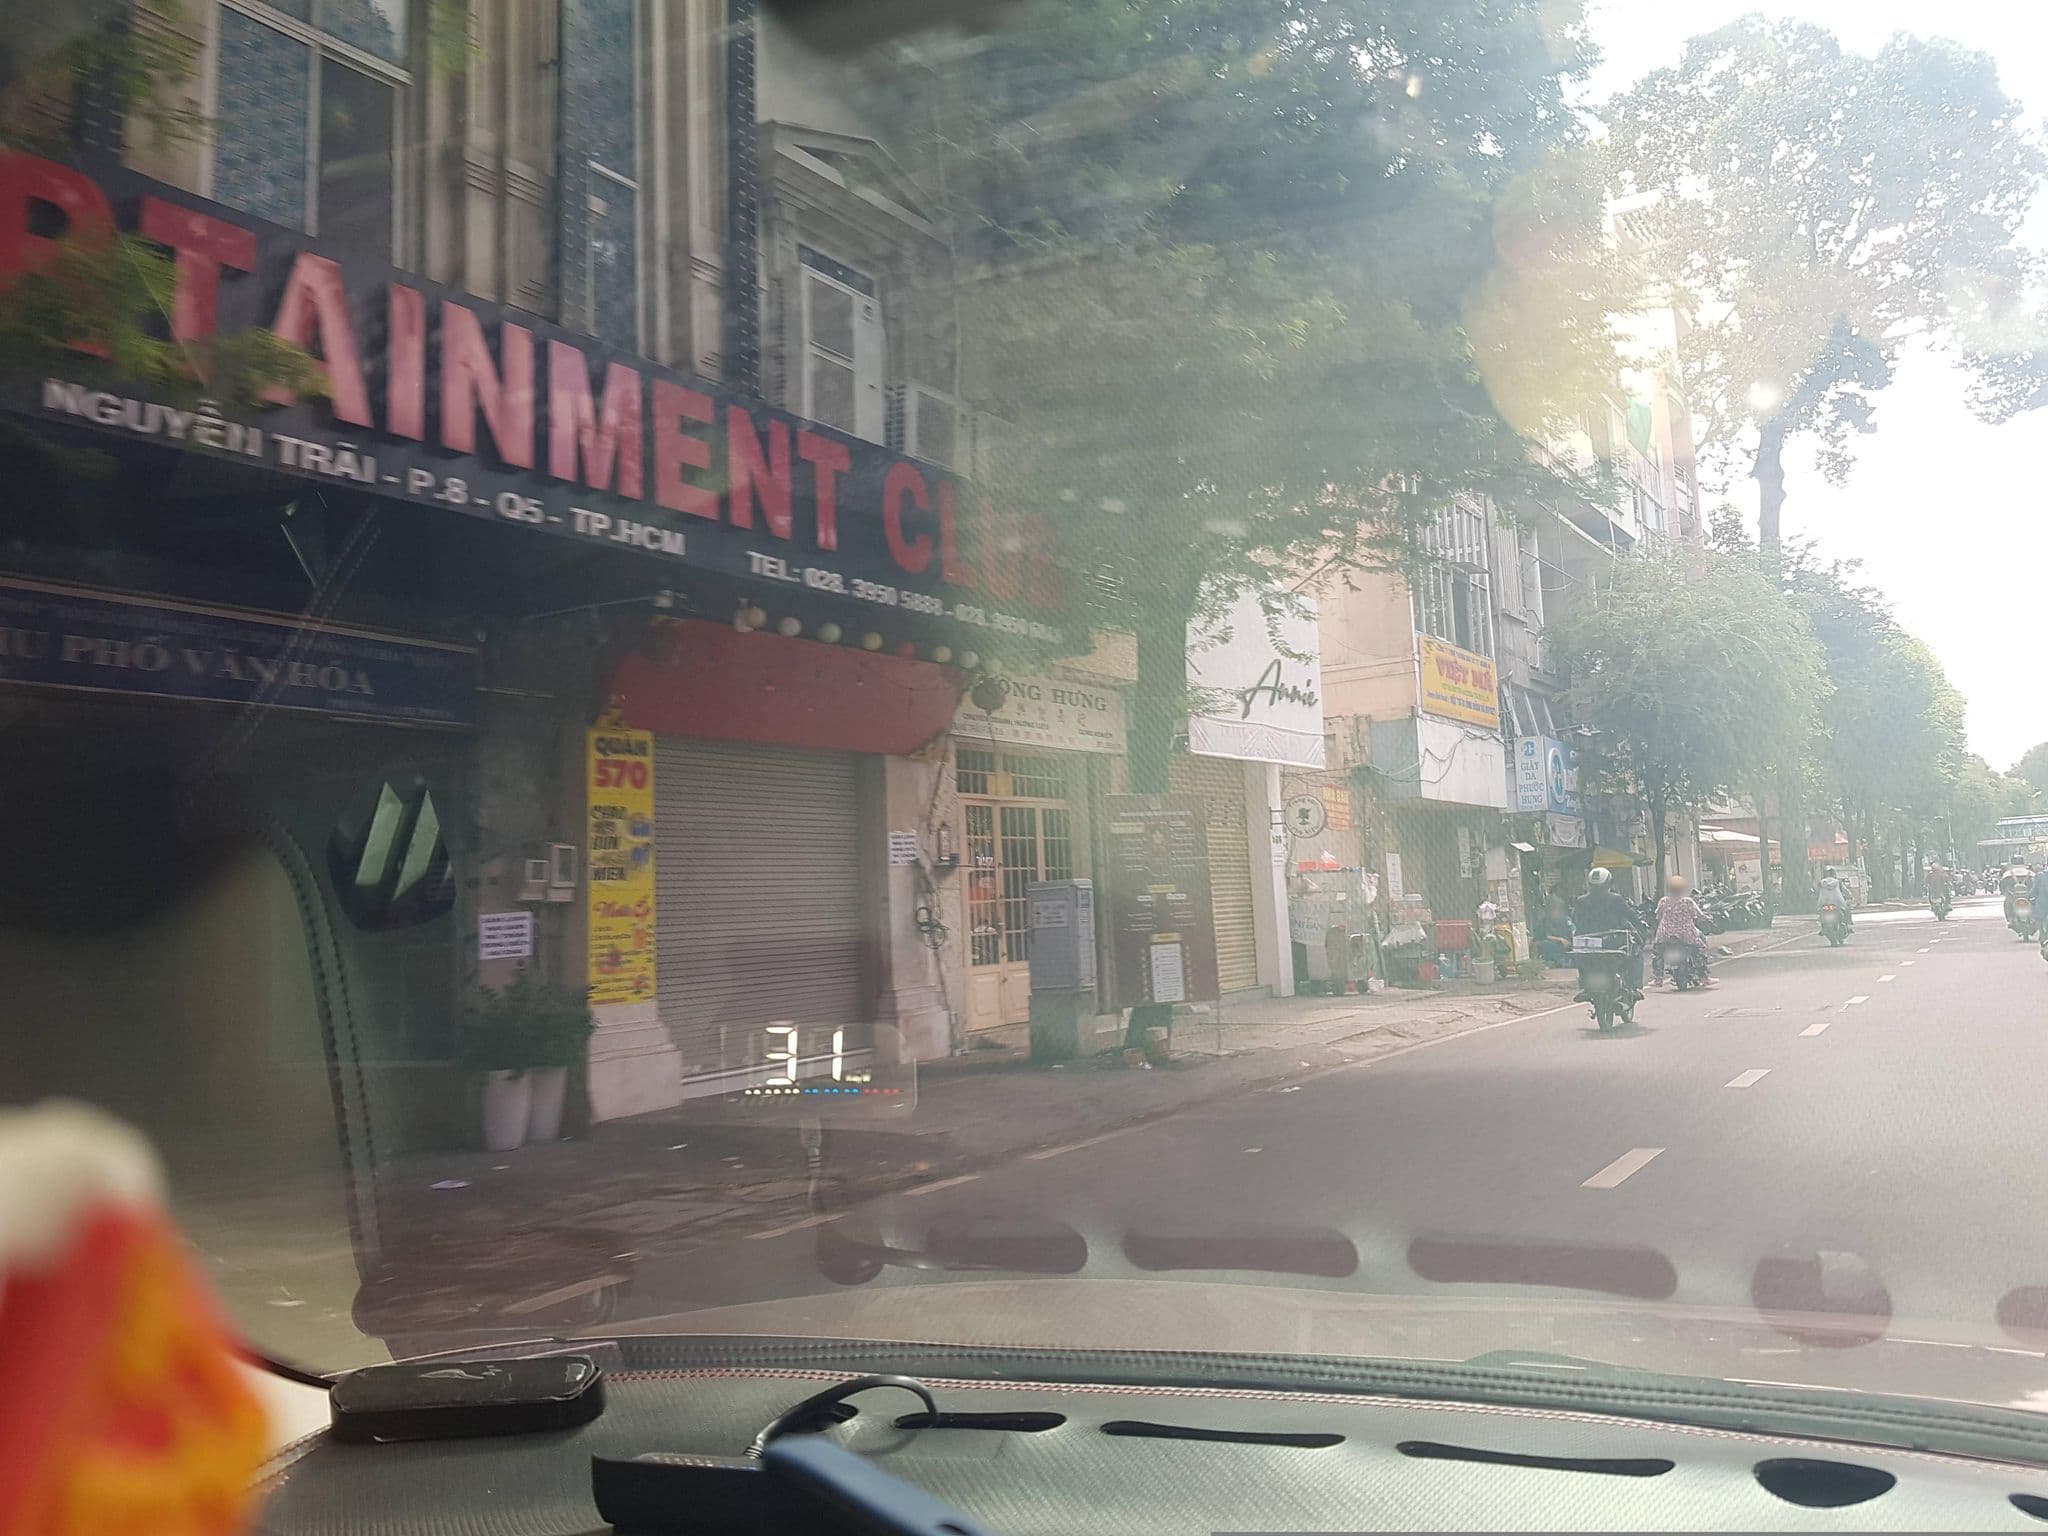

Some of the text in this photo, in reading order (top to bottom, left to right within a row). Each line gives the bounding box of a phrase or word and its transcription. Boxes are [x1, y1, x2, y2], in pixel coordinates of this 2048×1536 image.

[41, 375, 263, 459] NGUYỄN
[272, 431, 377, 484] TRÃI
[286, 660, 375, 696] HÓA
[594, 758, 648, 790] 570
[765, 1022, 845, 1087] 31
